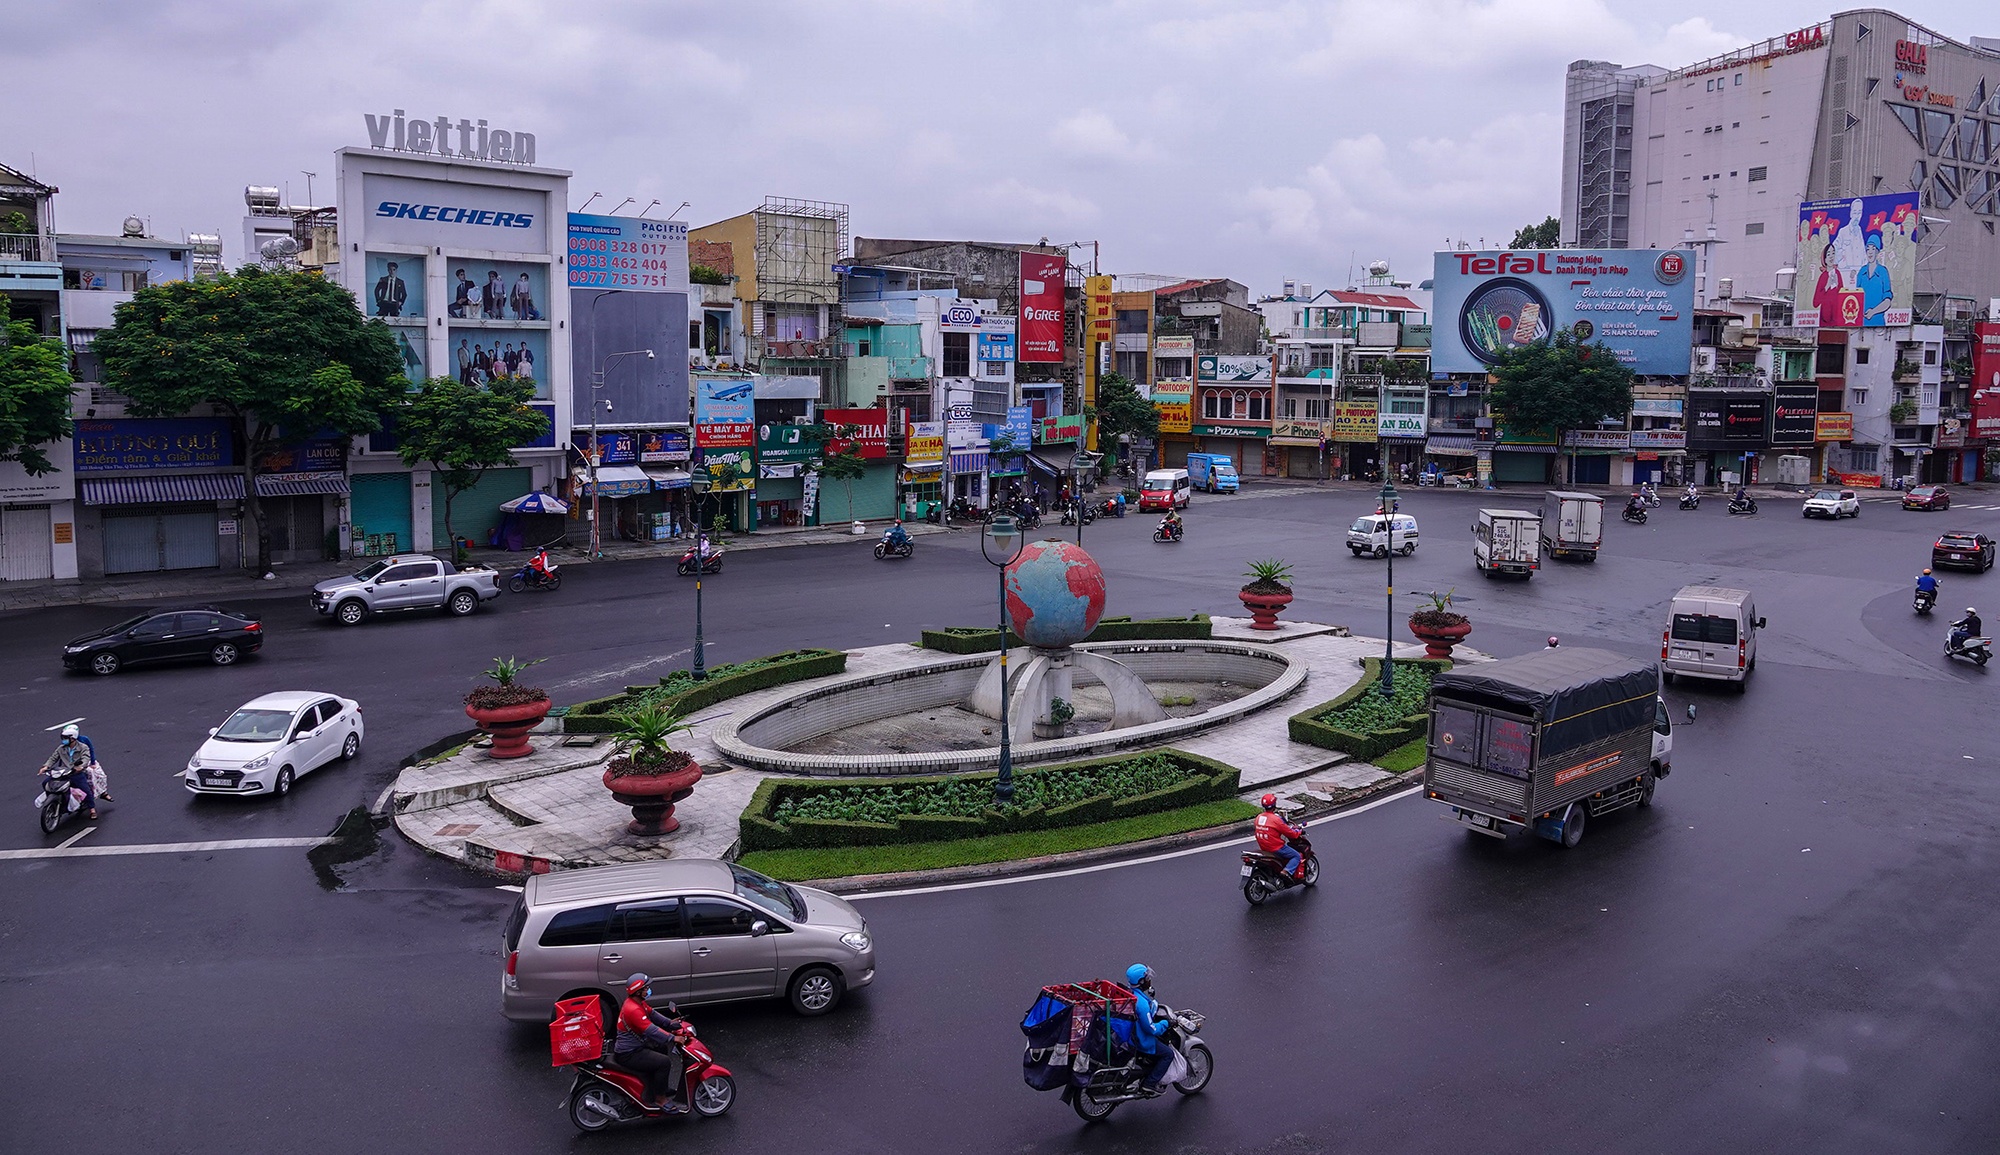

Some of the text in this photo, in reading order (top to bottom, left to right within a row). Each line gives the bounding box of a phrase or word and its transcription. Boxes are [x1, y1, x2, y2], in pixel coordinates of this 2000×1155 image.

[1786, 26, 1823, 48] GALA
[1786, 40, 1825, 56] CENTER
[1896, 39, 1927, 66] GALA
[1894, 60, 1926, 75] CENTER
[376, 201, 534, 228] SKECHERS
[642, 223, 688, 234] PACIFIC
[569, 238, 667, 255] 0908 328 017
[569, 254, 668, 271] 0933 462 404
[1454, 252, 1552, 275] Tefal
[1557, 255, 1603, 268] Thương Hiệu
[1556, 266, 1575, 274] Danh
[1577, 265, 1598, 276] Tiếng
[1609, 266, 1628, 277] Pháp
[570, 270, 667, 286] 0977 755 751
[1582, 287, 1600, 298] Bền
[1625, 287, 1644, 298] thời
[1646, 289, 1667, 302] gian
[1574, 301, 1673, 315] Bền chặt tình yêu bếp
[952, 310, 971, 321] ECO
[1034, 309, 1060, 321] GREE
[1048, 340, 1056, 352] 20
[1219, 364, 1240, 374] 50%
[1157, 383, 1190, 392] PHOTOCOPY
[714, 424, 732, 433] MÁY
[1380, 418, 1422, 429] AN HÒA
[1214, 426, 1239, 435] PIZZA
[1290, 426, 1319, 436] iPhone
[616, 440, 631, 451] 341
[85, 454, 118, 464] Điểm
[123, 454, 147, 463] tâm
[196, 451, 220, 461] khát
[307, 447, 340, 458] LAN CÚC
